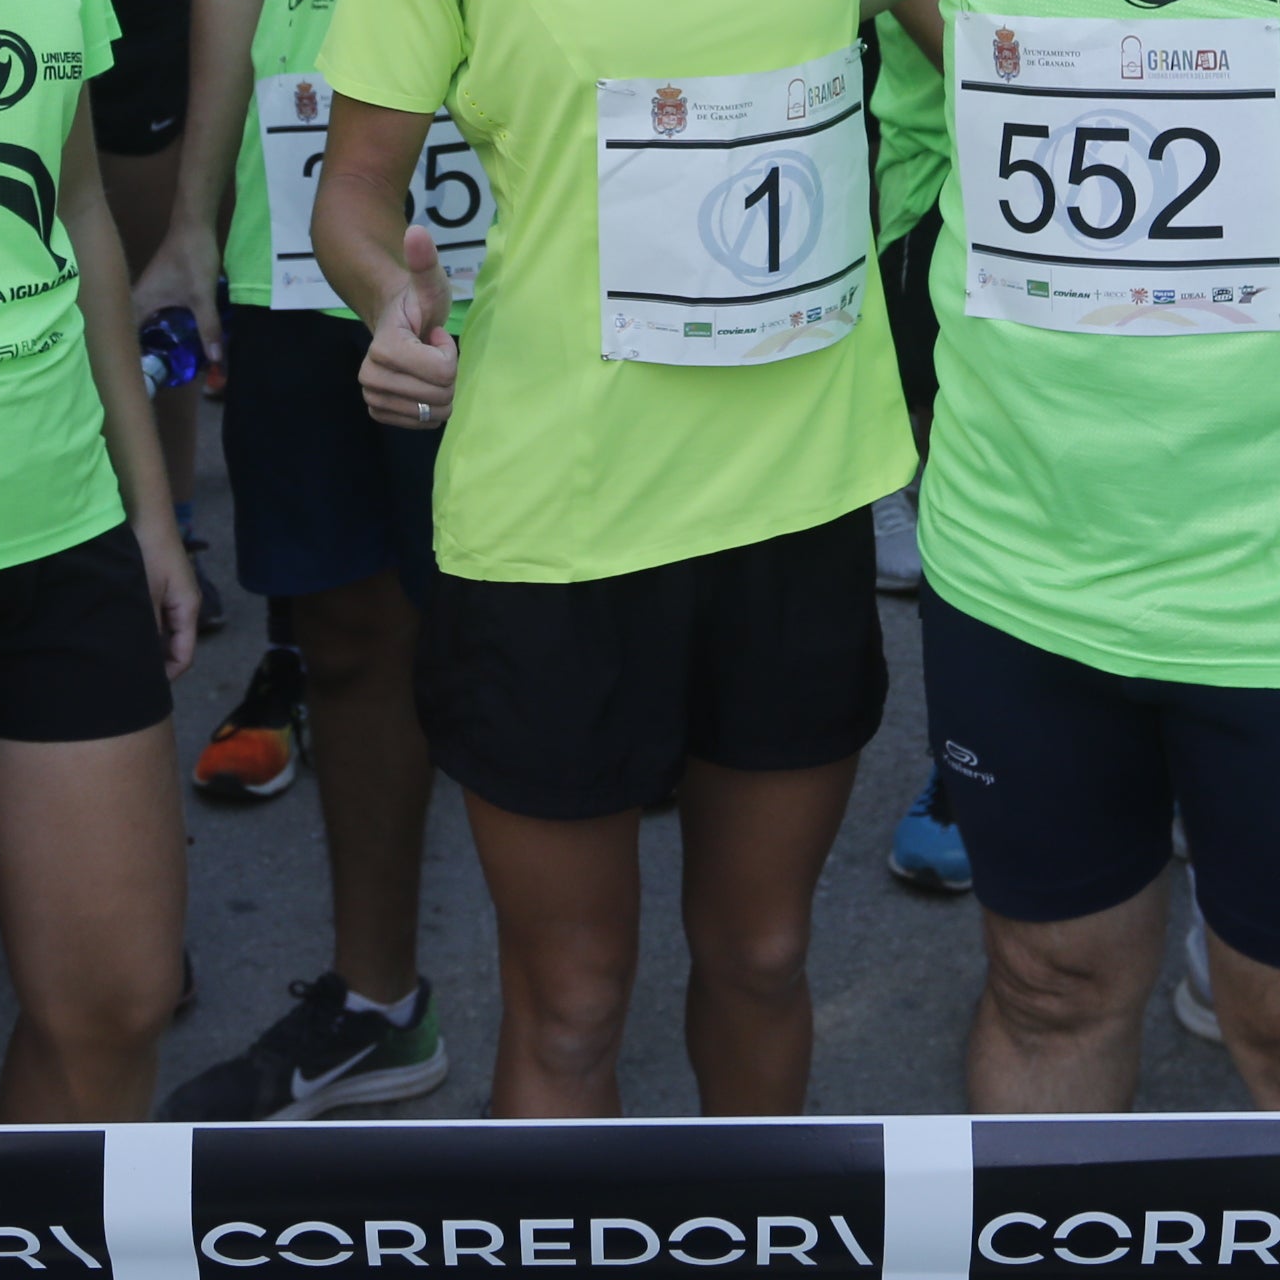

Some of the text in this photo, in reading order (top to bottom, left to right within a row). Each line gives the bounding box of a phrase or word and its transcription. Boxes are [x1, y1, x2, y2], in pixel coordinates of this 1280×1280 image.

[1023, 47, 1081, 57] AYUNTAMIENTO
[1038, 58, 1075, 68] GRANADA
[1148, 50, 1230, 71] GRANADA
[692, 101, 753, 111] AYUNTAMIENTO
[710, 111, 748, 121] GRANADA
[997, 122, 1224, 240] 552
[744, 166, 780, 273] 1
